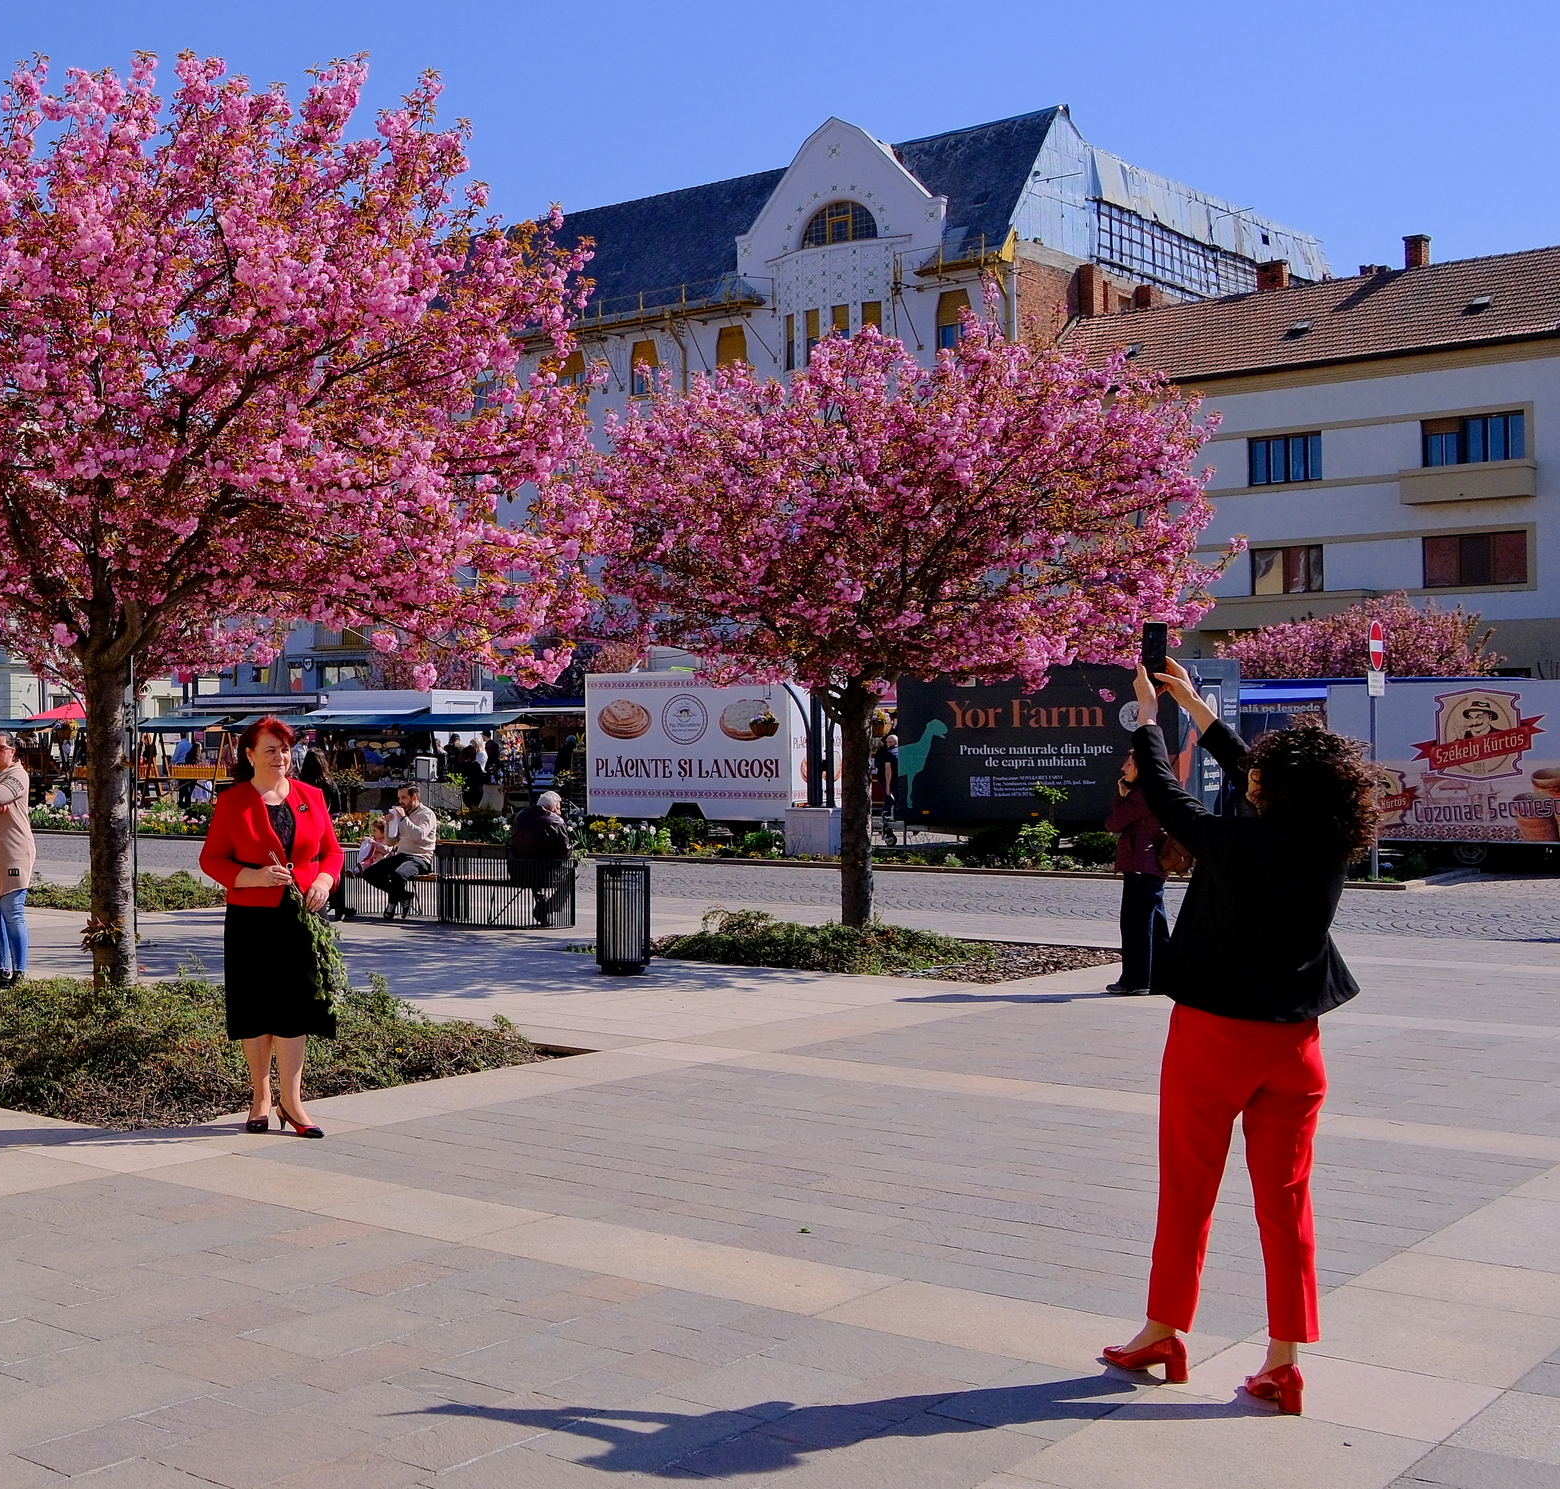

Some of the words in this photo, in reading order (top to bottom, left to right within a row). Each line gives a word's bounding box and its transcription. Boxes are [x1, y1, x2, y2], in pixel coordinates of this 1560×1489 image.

[946, 700, 1002, 729] Yor
[1011, 699, 1105, 728] Farm
[959, 744, 1006, 755] Produse
[1009, 744, 1058, 755] naturale
[1060, 743, 1081, 754] din
[1083, 743, 1113, 756] lapte
[1436, 743, 1480, 764] Székely
[1483, 733, 1524, 753] Kürtös
[595, 755, 673, 779] PLĂCINTE
[677, 758, 694, 782] ȘI
[698, 758, 780, 782] LANGOȘI
[985, 757, 999, 767] de
[1001, 757, 1035, 769] capră
[1037, 756, 1087, 767] nubiană
[1381, 796, 1407, 809] Kürtös
[1414, 801, 1482, 823] Cozonac
